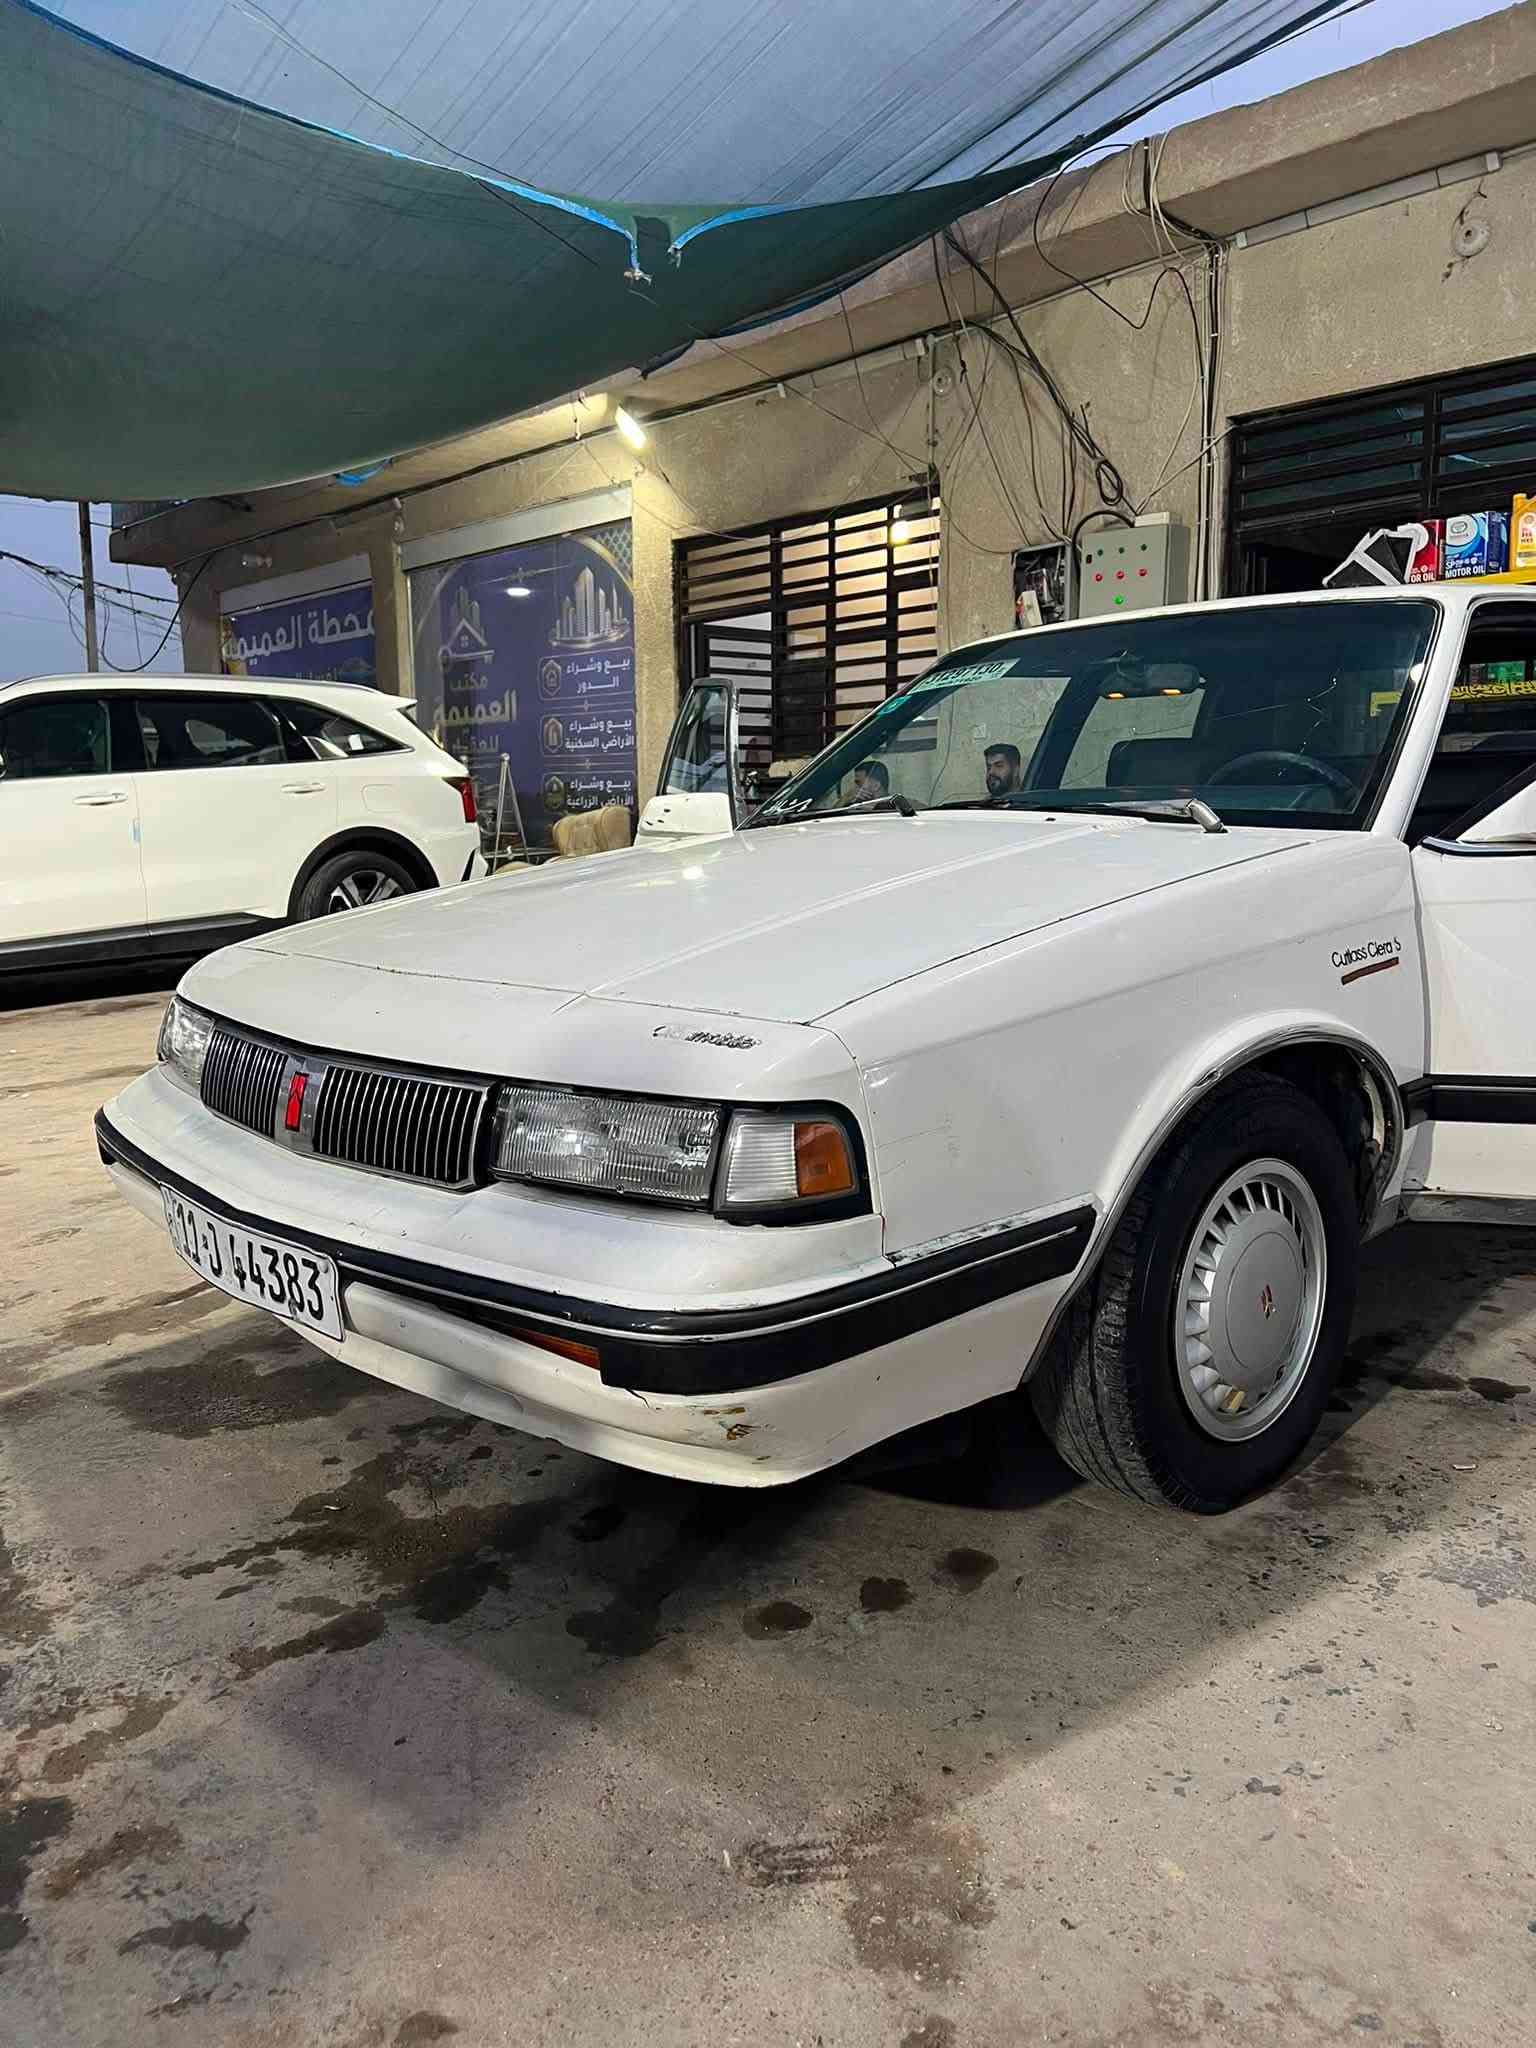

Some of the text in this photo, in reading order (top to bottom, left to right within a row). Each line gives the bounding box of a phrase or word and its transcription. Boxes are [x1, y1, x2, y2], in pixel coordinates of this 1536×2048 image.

[1422, 572, 1436, 582] OIL
[1445, 564, 1487, 579] MOTOR OIL
[576, 676, 620, 694] الدور
[1331, 946, 1367, 968] Cutlass
[1393, 936, 1402, 952] S
[228, 1233, 324, 1321] 44383
